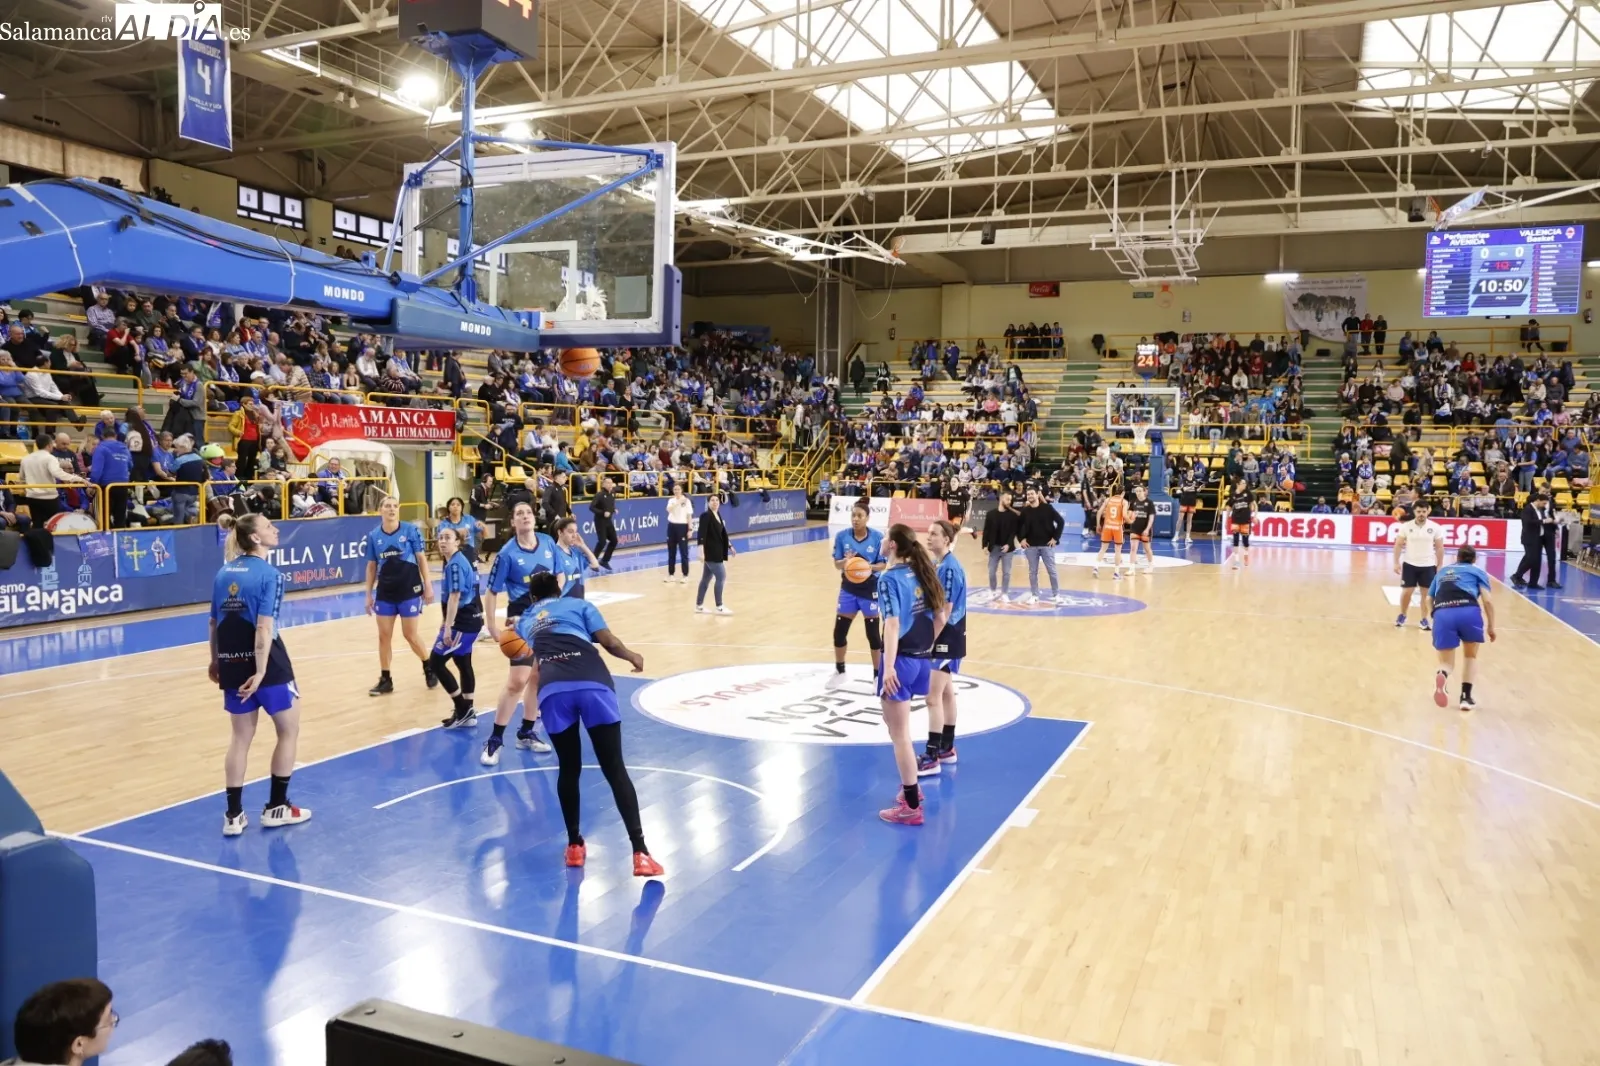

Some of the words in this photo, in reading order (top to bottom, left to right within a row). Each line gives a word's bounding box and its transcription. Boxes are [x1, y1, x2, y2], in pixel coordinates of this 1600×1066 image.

[197, 57, 212, 96] 4
[1519, 228, 1562, 237] VALENCIA
[1526, 235, 1555, 243] Basket
[1449, 238, 1486, 246] AVENIDA
[1481, 247, 1489, 259] 0
[1515, 246, 1524, 258] 0
[1479, 279, 1523, 293] 10:50
[323, 285, 365, 302] MONDO
[460, 321, 492, 336] MONDO
[1137, 355, 1154, 368] 24
[359, 409, 438, 426] AMANCA
[364, 425, 378, 437] DE
[380, 426, 394, 438] LA
[396, 427, 452, 439] HUMANIDAD
[1109, 506, 1118, 519] 9
[629, 517, 636, 532] Y
[638, 512, 659, 529] LEÓN
[322, 543, 334, 565] Y
